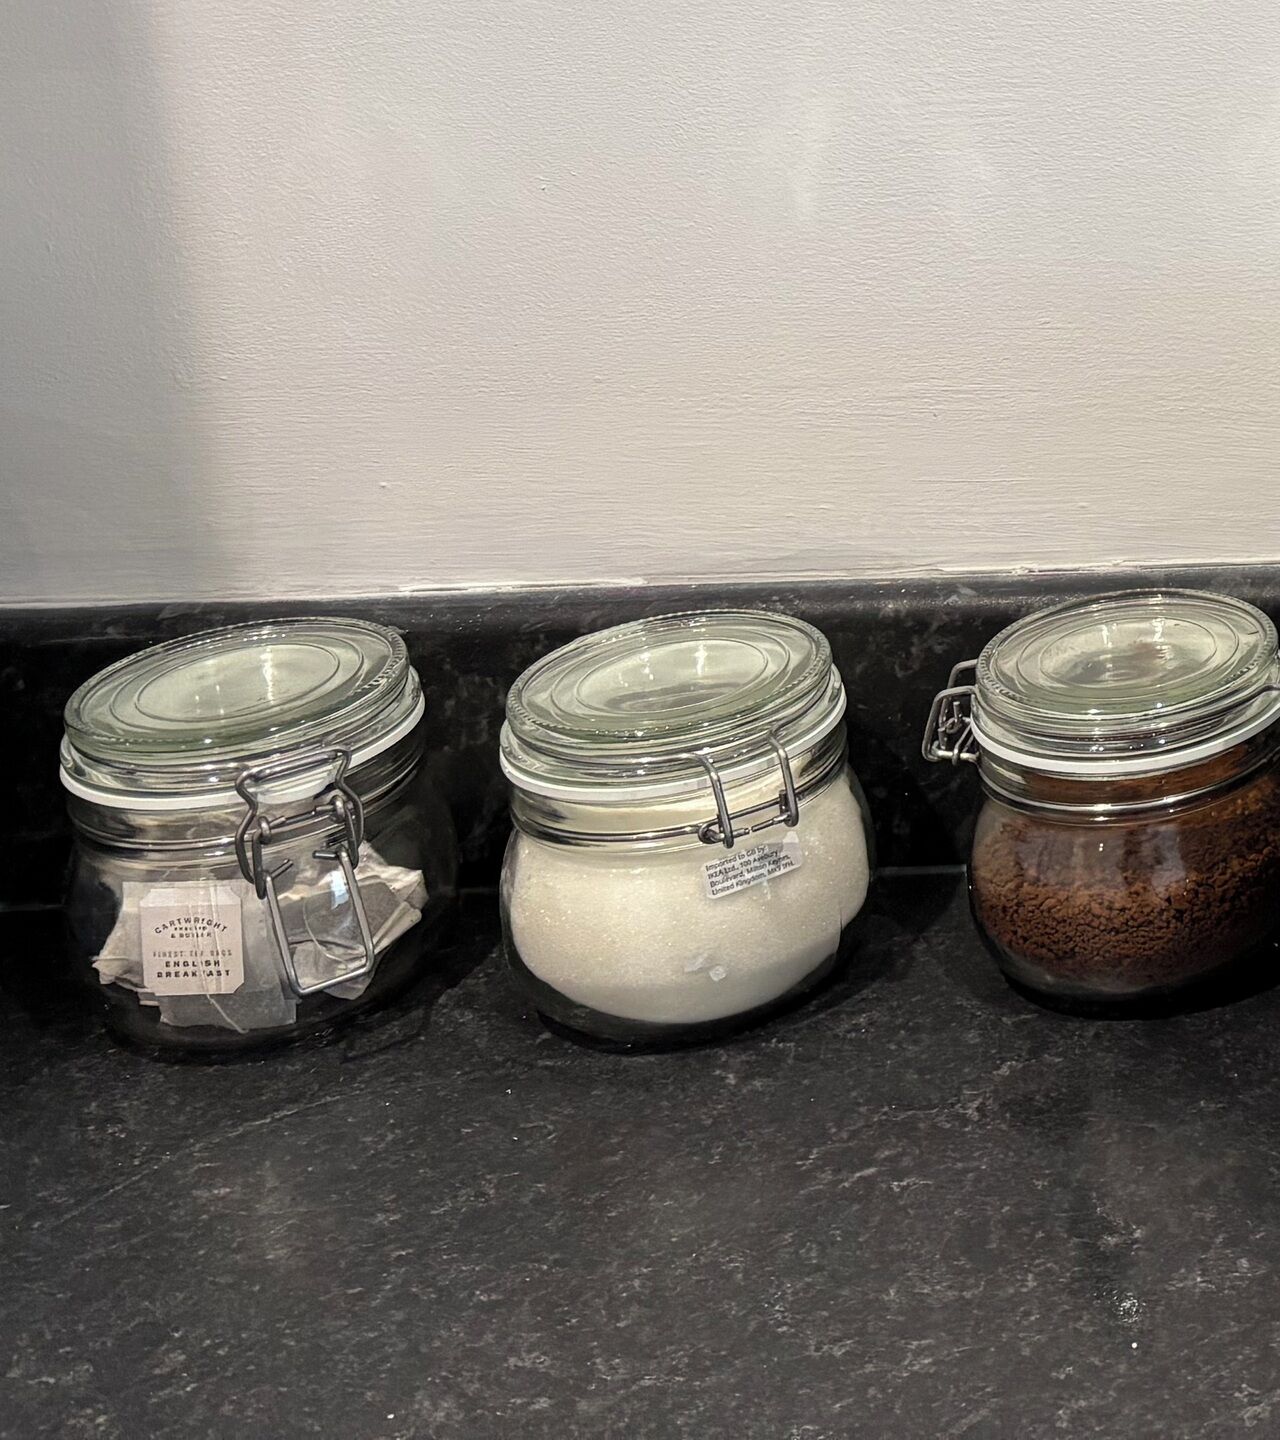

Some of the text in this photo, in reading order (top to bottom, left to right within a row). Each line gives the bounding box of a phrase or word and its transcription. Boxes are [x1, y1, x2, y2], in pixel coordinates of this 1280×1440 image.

[705, 854, 737, 872] Imported
[711, 882, 735, 896] United
[153, 916, 228, 935] CARTWRIGHT
